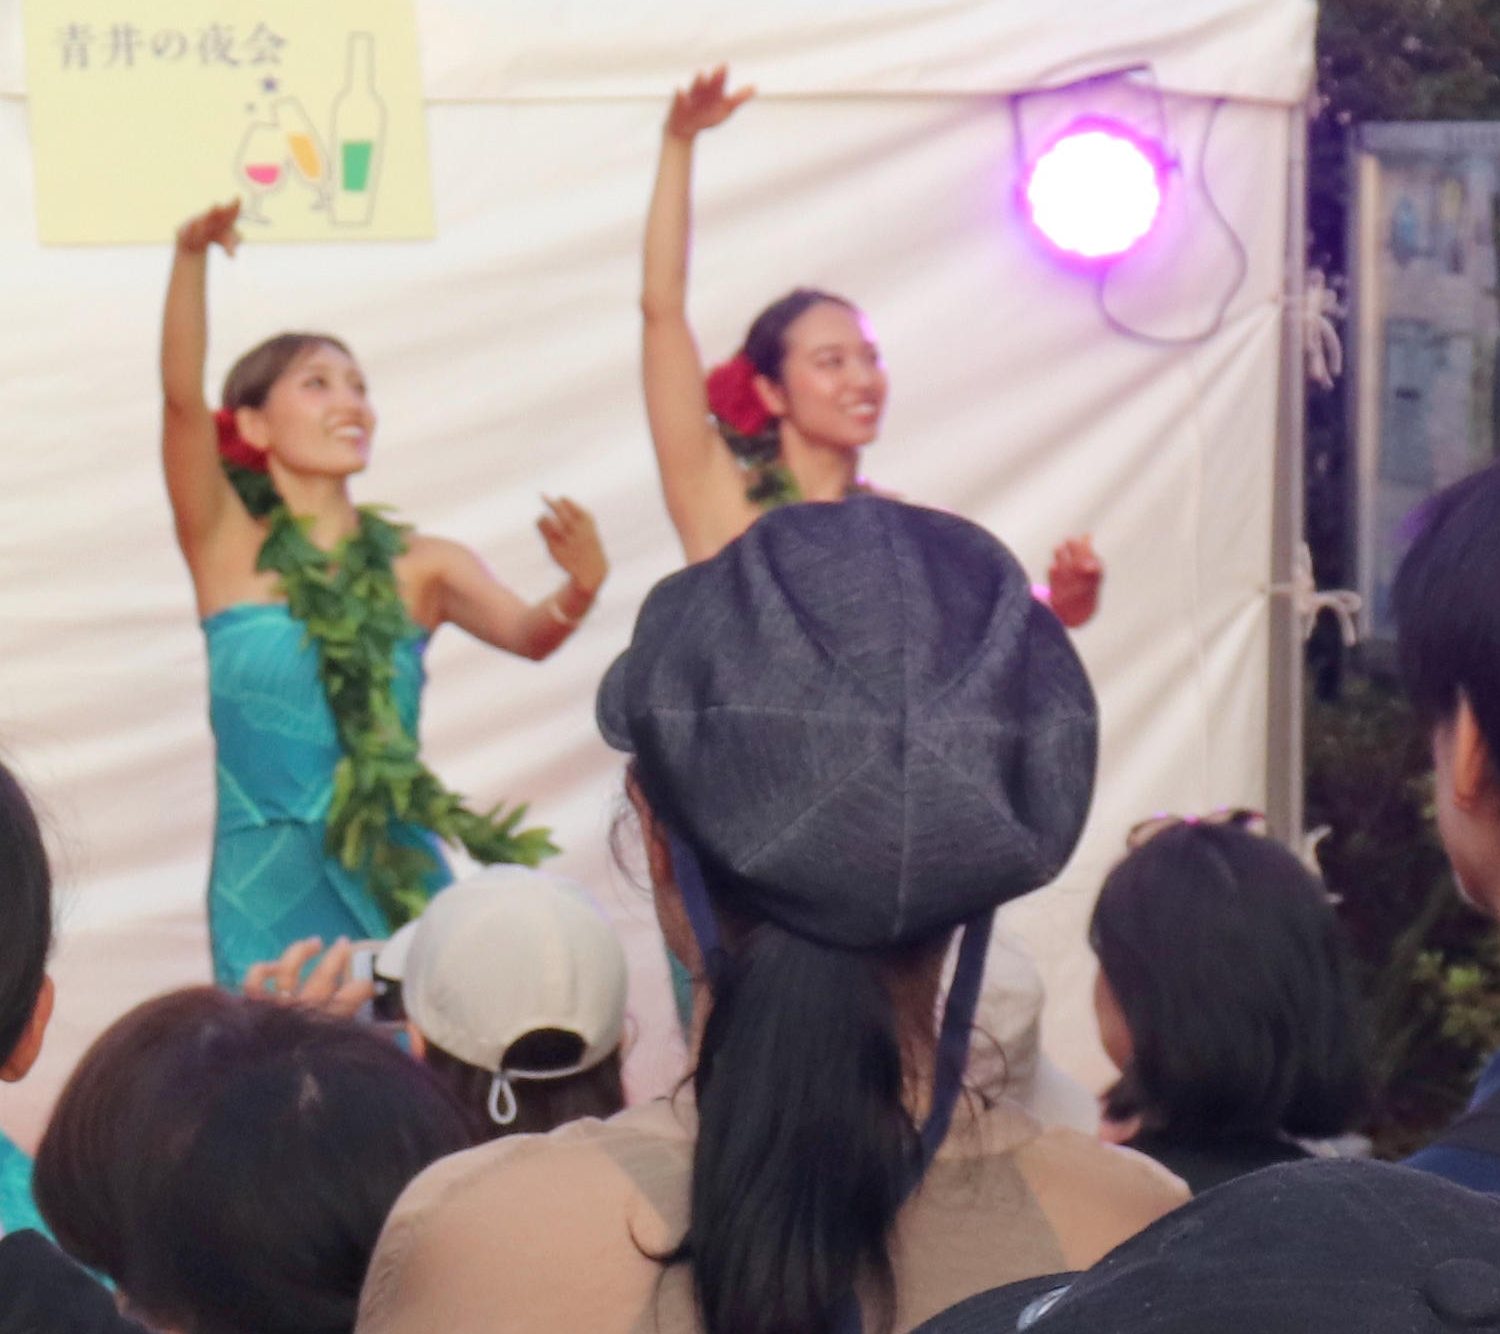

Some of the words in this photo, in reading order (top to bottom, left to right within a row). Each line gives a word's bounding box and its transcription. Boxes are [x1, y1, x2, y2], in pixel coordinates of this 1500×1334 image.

[57, 21, 287, 70] 青井の夜会
